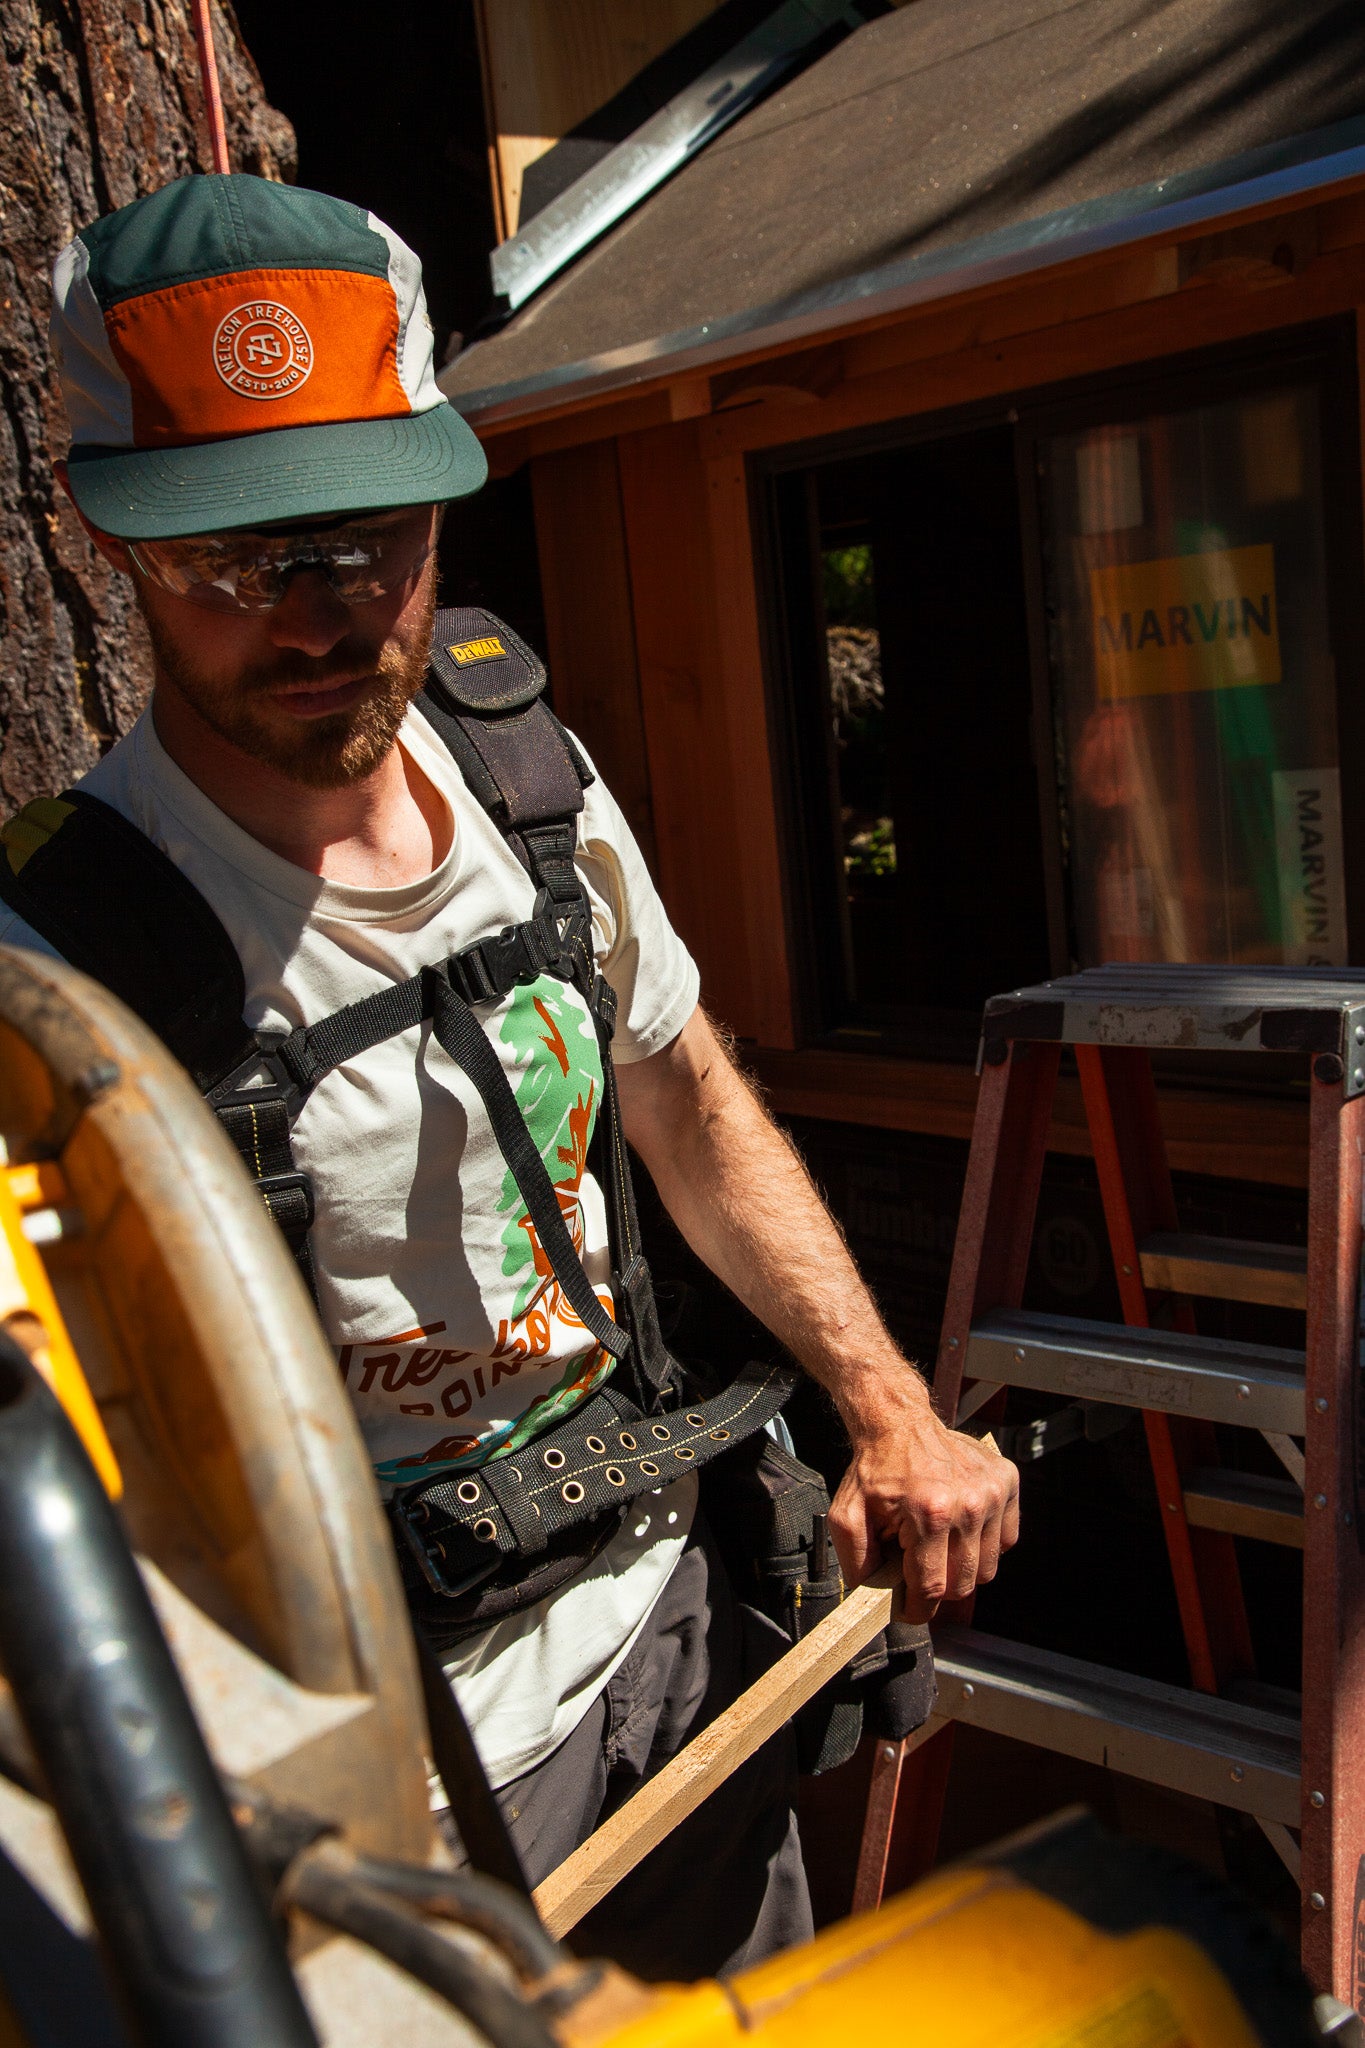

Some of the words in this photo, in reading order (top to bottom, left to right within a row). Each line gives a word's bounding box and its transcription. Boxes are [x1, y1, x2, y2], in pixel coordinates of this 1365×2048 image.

[218, 316, 243, 372] NELSON
[245, 305, 308, 364] TREEHOUSE
[1099, 593, 1271, 653] MARVIN
[1297, 788, 1330, 943] MARVIN
